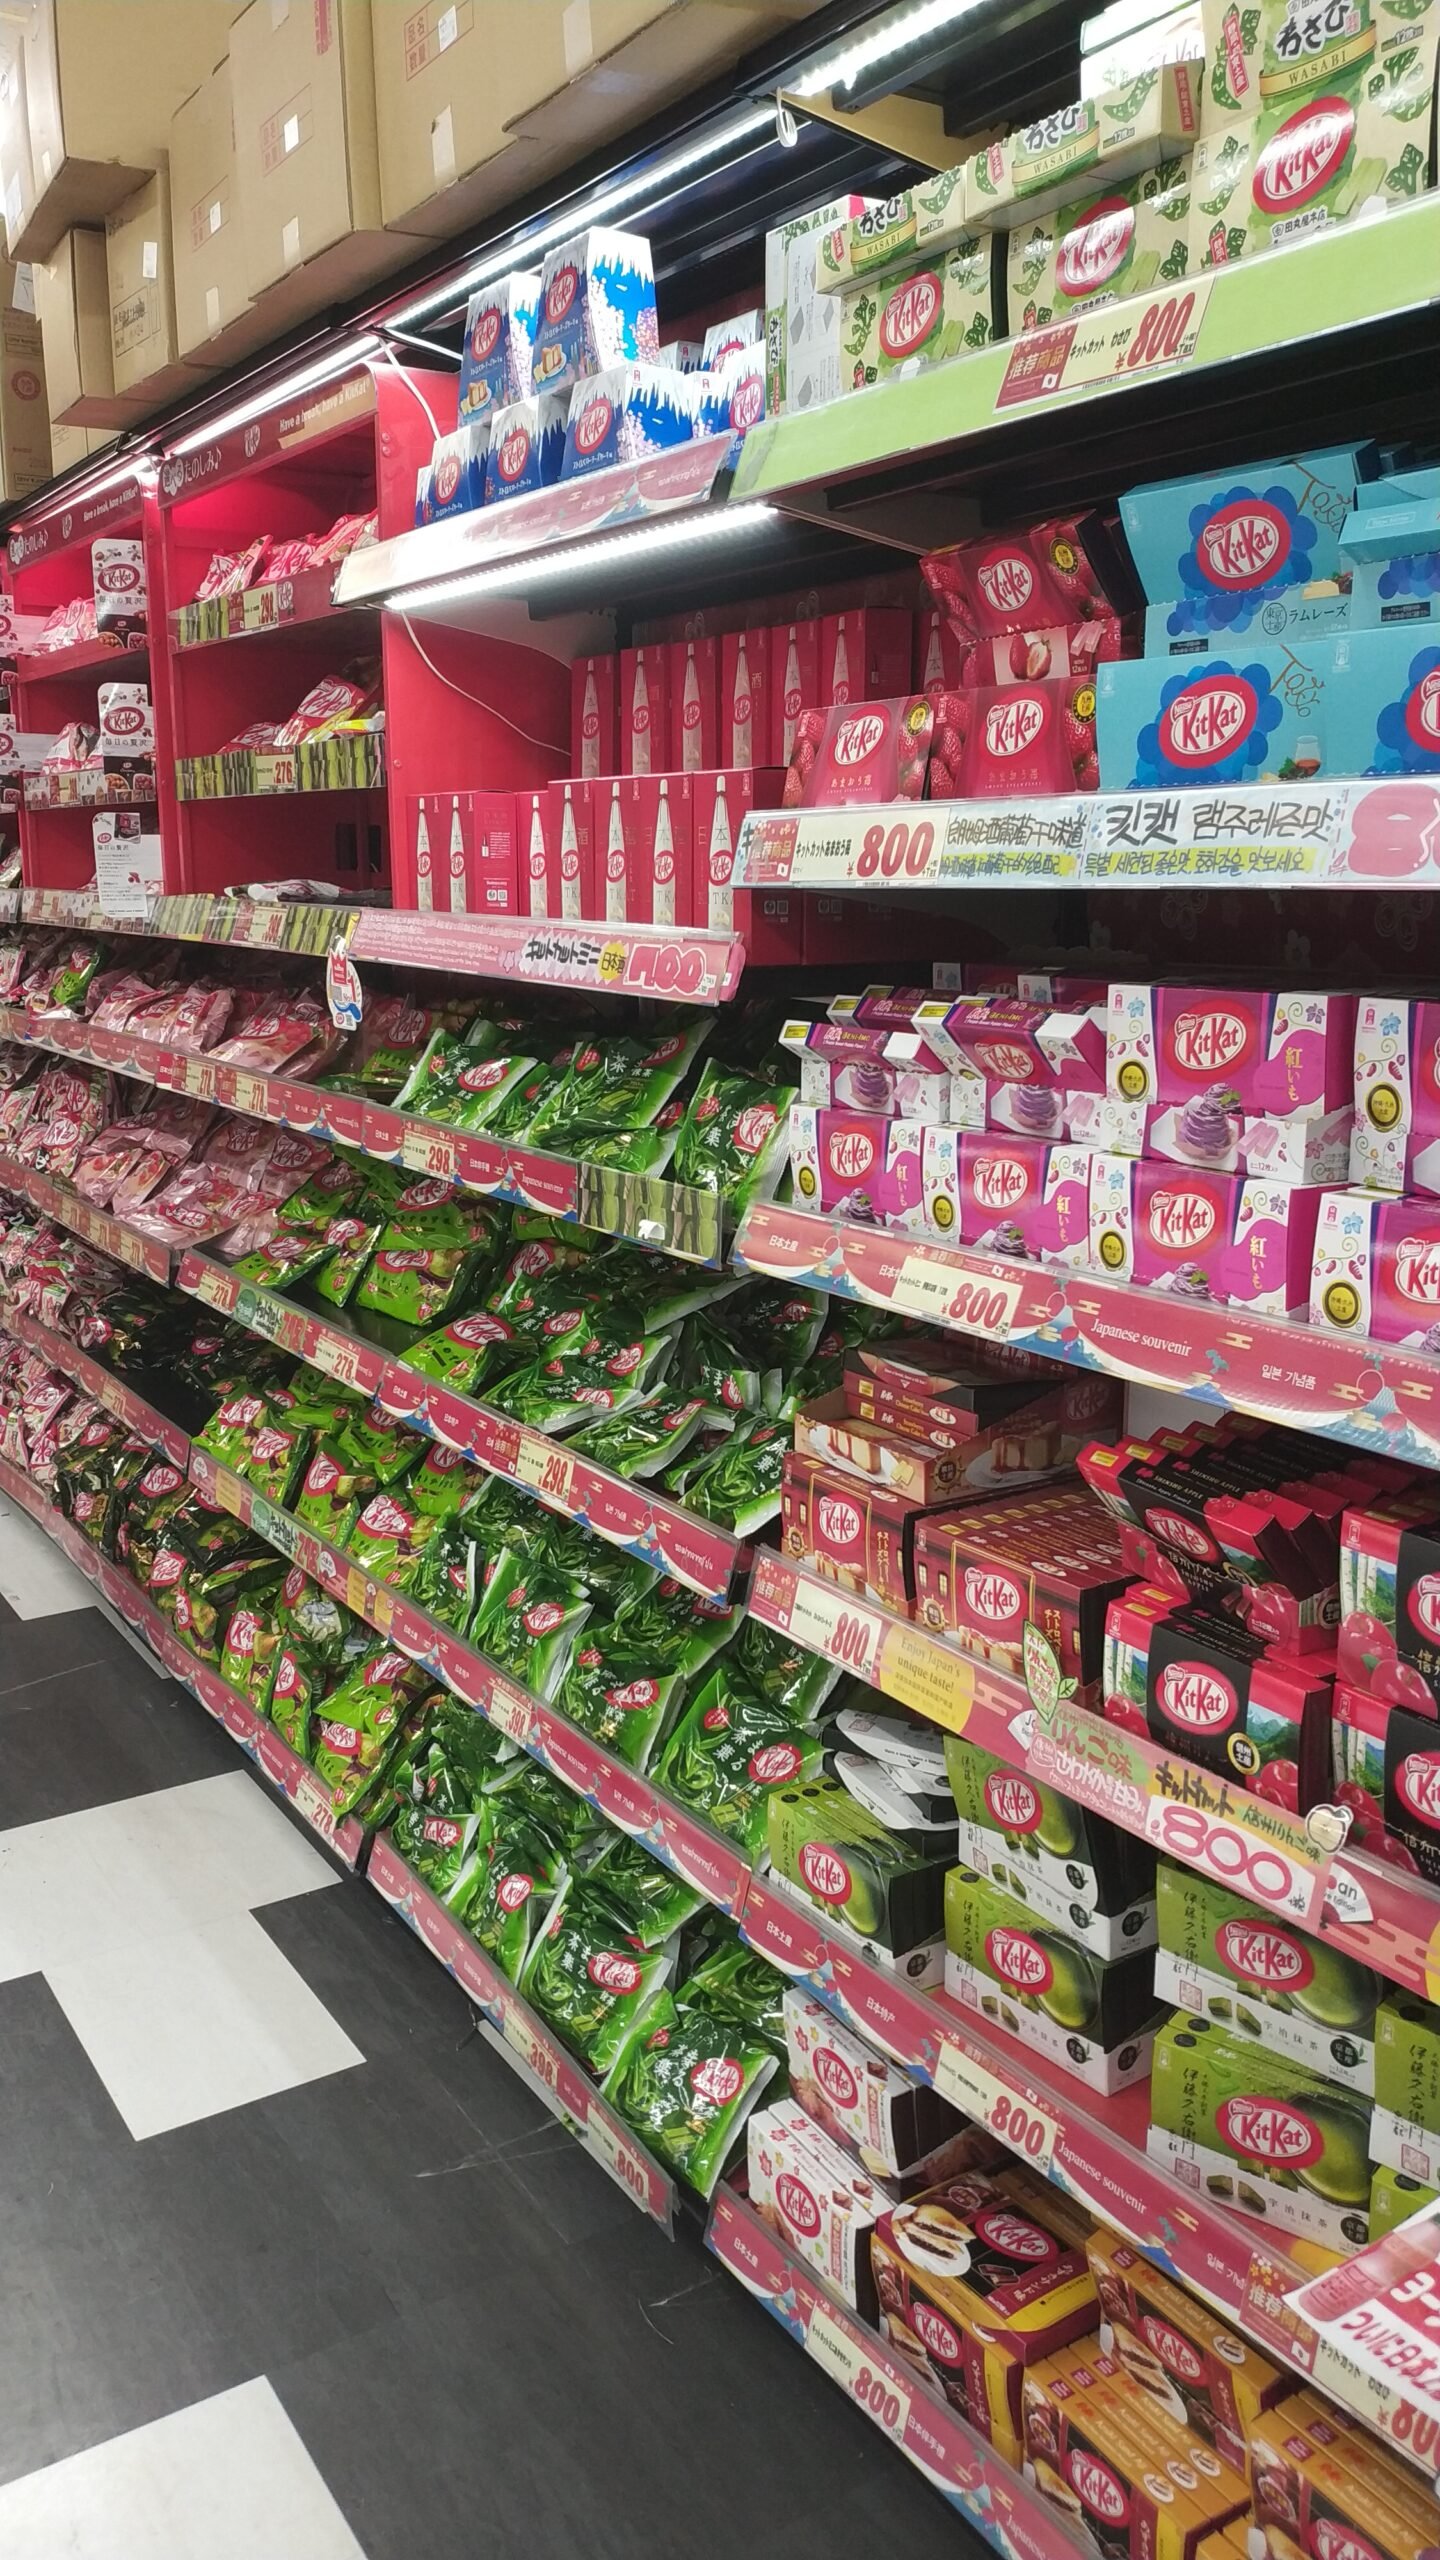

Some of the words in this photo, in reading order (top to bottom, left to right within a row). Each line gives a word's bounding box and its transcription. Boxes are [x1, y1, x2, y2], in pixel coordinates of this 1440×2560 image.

[1288, 50, 1348, 86] WASABI
[1033, 147, 1078, 175] WASABI
[866, 235, 901, 257] WASABI
[893, 286, 931, 345] KitKat
[1010, 343, 1065, 380] 推荐商品
[279, 414, 295, 433] Have
[1218, 520, 1273, 574] KitKat
[107, 569, 133, 587] KitKat
[990, 559, 1030, 609] KitKat
[113, 711, 138, 730] KitKat
[841, 720, 882, 764] KitKat
[992, 705, 1040, 752] KitKat
[1182, 695, 1239, 750] KitKat
[1106, 799, 1181, 847] 킷캣
[1186, 1015, 1239, 1067] KitKat
[469, 1063, 503, 1085] KitKat
[1285, 1046, 1304, 1102] 紅いも
[837, 1133, 869, 1176] KitKat
[895, 1164, 910, 1207] 紅いも
[982, 1162, 1023, 1204] KitKat
[1055, 1195, 1072, 1244] 紅いも
[1158, 1197, 1208, 1244] KitKat
[1249, 1237, 1267, 1290] 紅いも
[1091, 1318, 1141, 1345] Japanese
[1140, 1333, 1193, 1357] souvenir
[1261, 1363, 1283, 1382] 일본
[1283, 1370, 1318, 1392] 기념품
[826, 1503, 856, 1541] KitKat
[973, 1578, 1015, 1618] KitKat
[896, 1655, 927, 1680] unique
[927, 1671, 954, 1695] taste!
[900, 1635, 924, 1660] Enjoy
[926, 1654, 961, 1678] Japan's
[1173, 1674, 1223, 1723] KitKat
[1051, 1719, 1133, 1781] りんご味
[998, 1778, 1032, 1826] KitKat
[809, 1858, 847, 1894] KitKat
[1000, 1942, 1041, 1984] KitKat
[1236, 1939, 1296, 1977] KitKat
[822, 2060, 851, 2099] KitKat
[1240, 2111, 1304, 2157] KitKat
[1057, 2139, 1102, 2183] Japanese
[1101, 2175, 1149, 2216] souvenir
[784, 2189, 814, 2229] KitKat
[989, 2221, 1044, 2253] KitKat
[919, 2315, 954, 2356] KitKat
[1147, 2329, 1200, 2376] KitKat
[1072, 2464, 1124, 2516] KitKat
